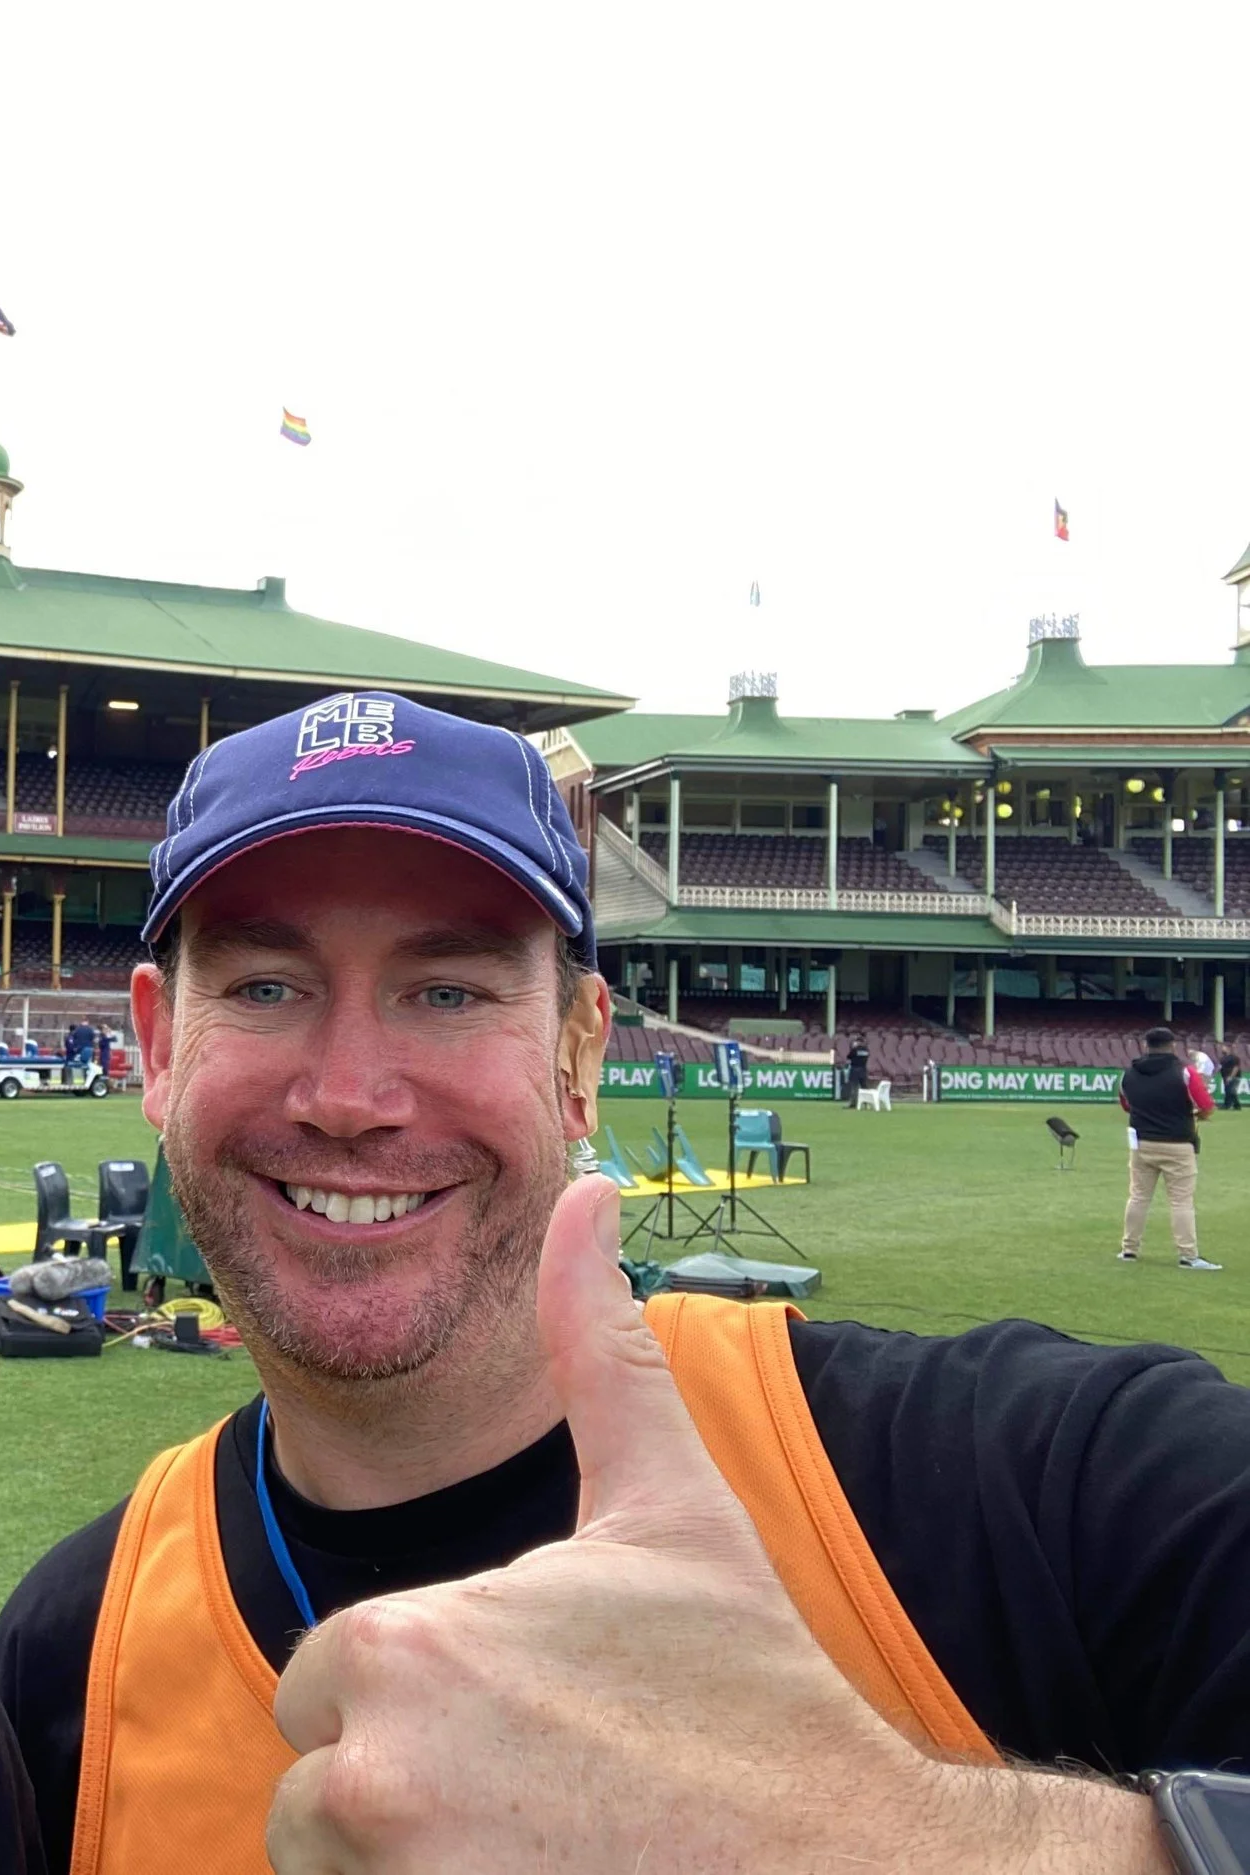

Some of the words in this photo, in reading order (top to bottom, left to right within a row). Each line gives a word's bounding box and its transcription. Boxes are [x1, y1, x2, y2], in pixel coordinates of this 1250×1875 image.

[290, 739, 417, 781] Rebels
[608, 1067, 655, 1086] PLAY
[697, 1069, 753, 1088] LOG
[756, 1069, 798, 1088] MAY
[801, 1070, 833, 1089] WE
[987, 1072, 1029, 1091] MAY
[1033, 1072, 1065, 1091] WE
[1069, 1073, 1118, 1092] PLAY
